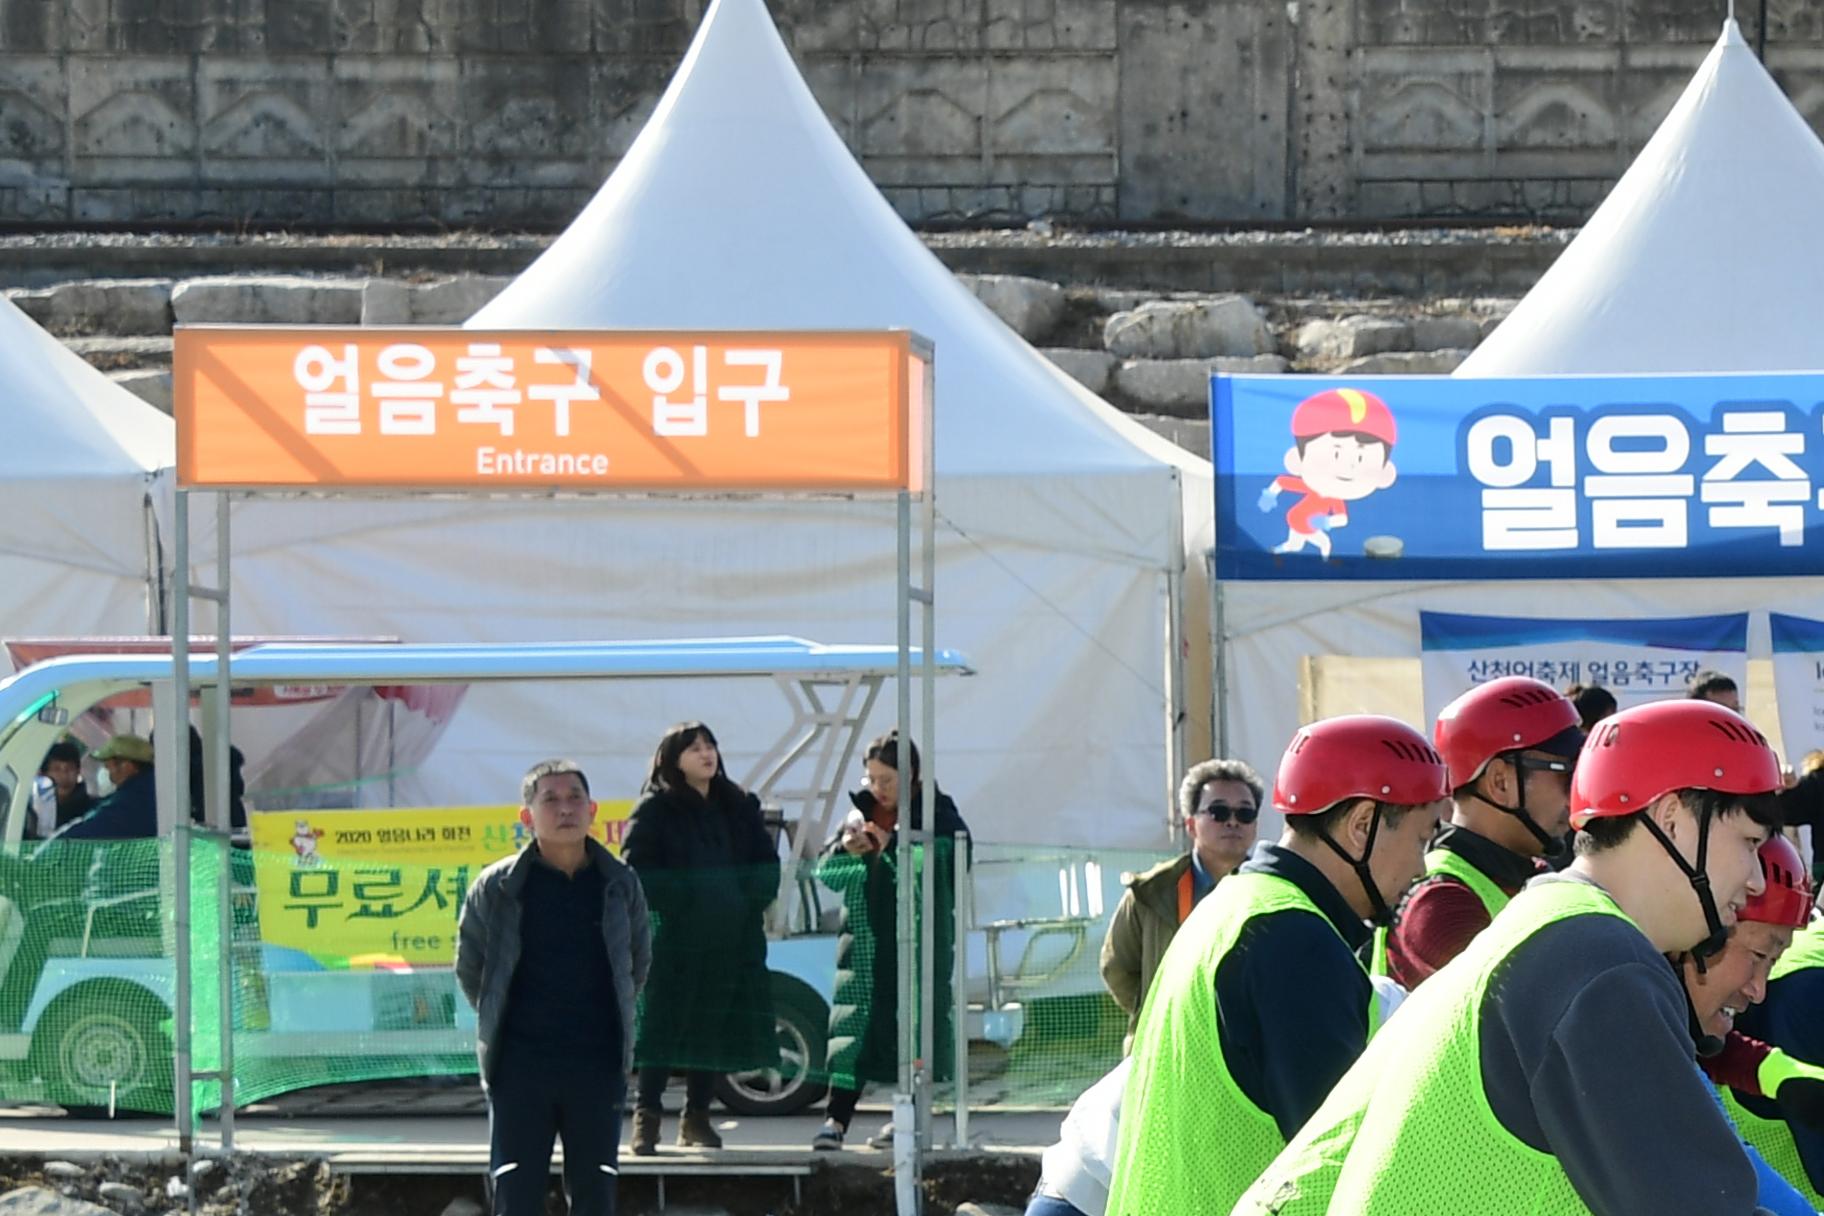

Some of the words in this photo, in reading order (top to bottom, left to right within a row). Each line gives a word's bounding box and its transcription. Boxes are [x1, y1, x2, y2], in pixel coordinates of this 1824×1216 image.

[293, 343, 600, 437] 얼음축구
[643, 344, 791, 437] 입구
[476, 447, 609, 476] Entrance
[1588, 659, 1701, 686] 얼음축구장
[335, 830, 371, 845] 2020
[378, 828, 436, 844] 얼음나라
[284, 864, 469, 930] 무료셔
[392, 930, 441, 951] free
